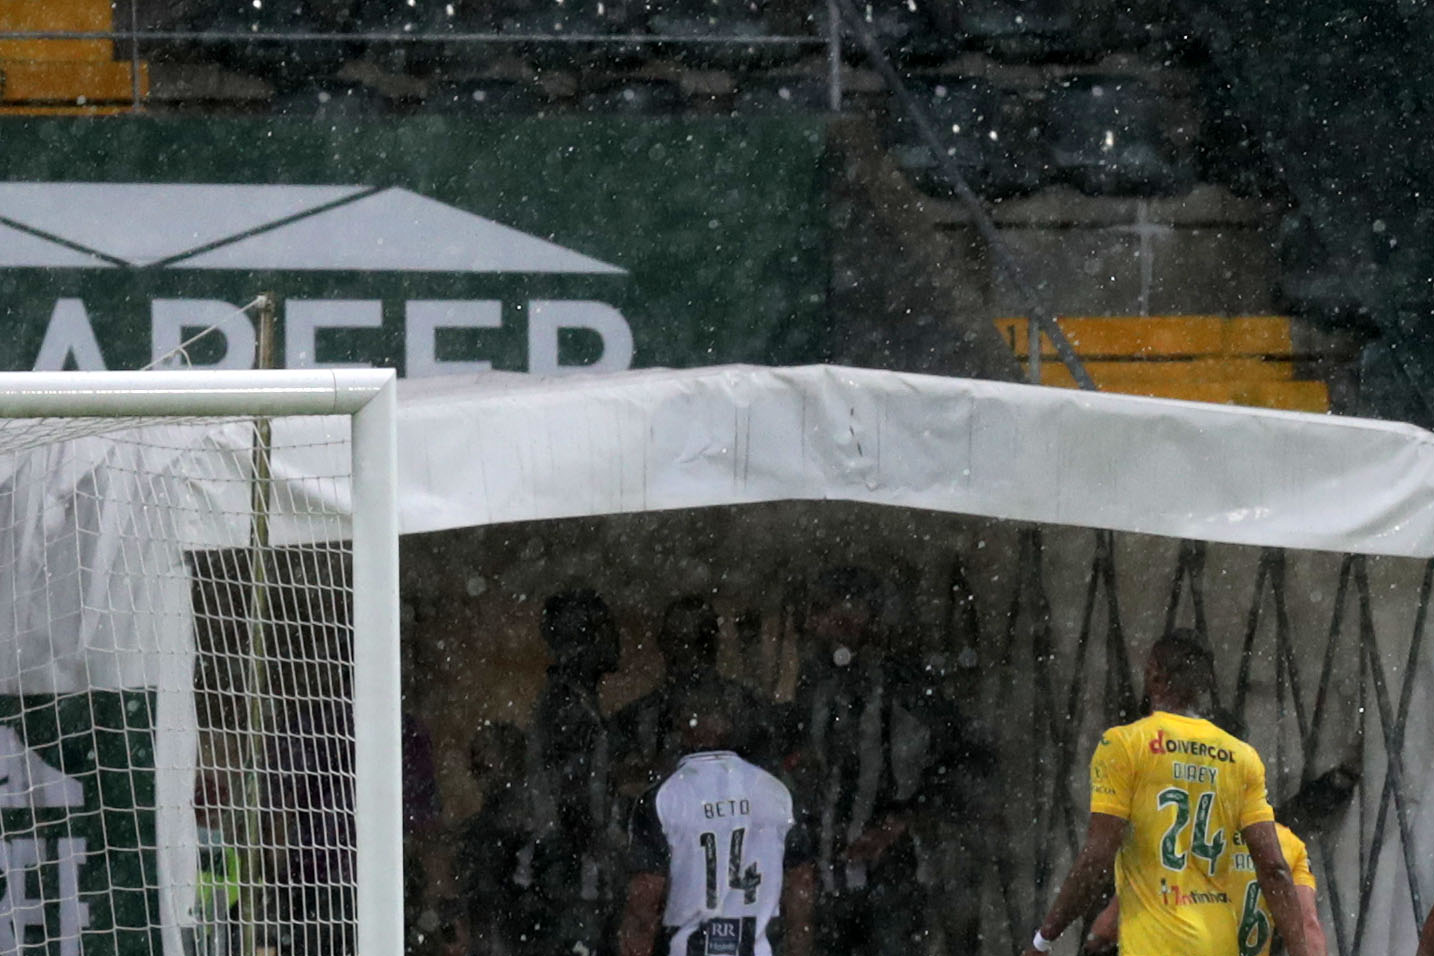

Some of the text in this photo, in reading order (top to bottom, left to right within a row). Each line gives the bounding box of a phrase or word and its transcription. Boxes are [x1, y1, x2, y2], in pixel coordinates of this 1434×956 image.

[704, 800, 749, 819] BETO
[1157, 786, 1226, 876] 24
[700, 828, 762, 910] 14
